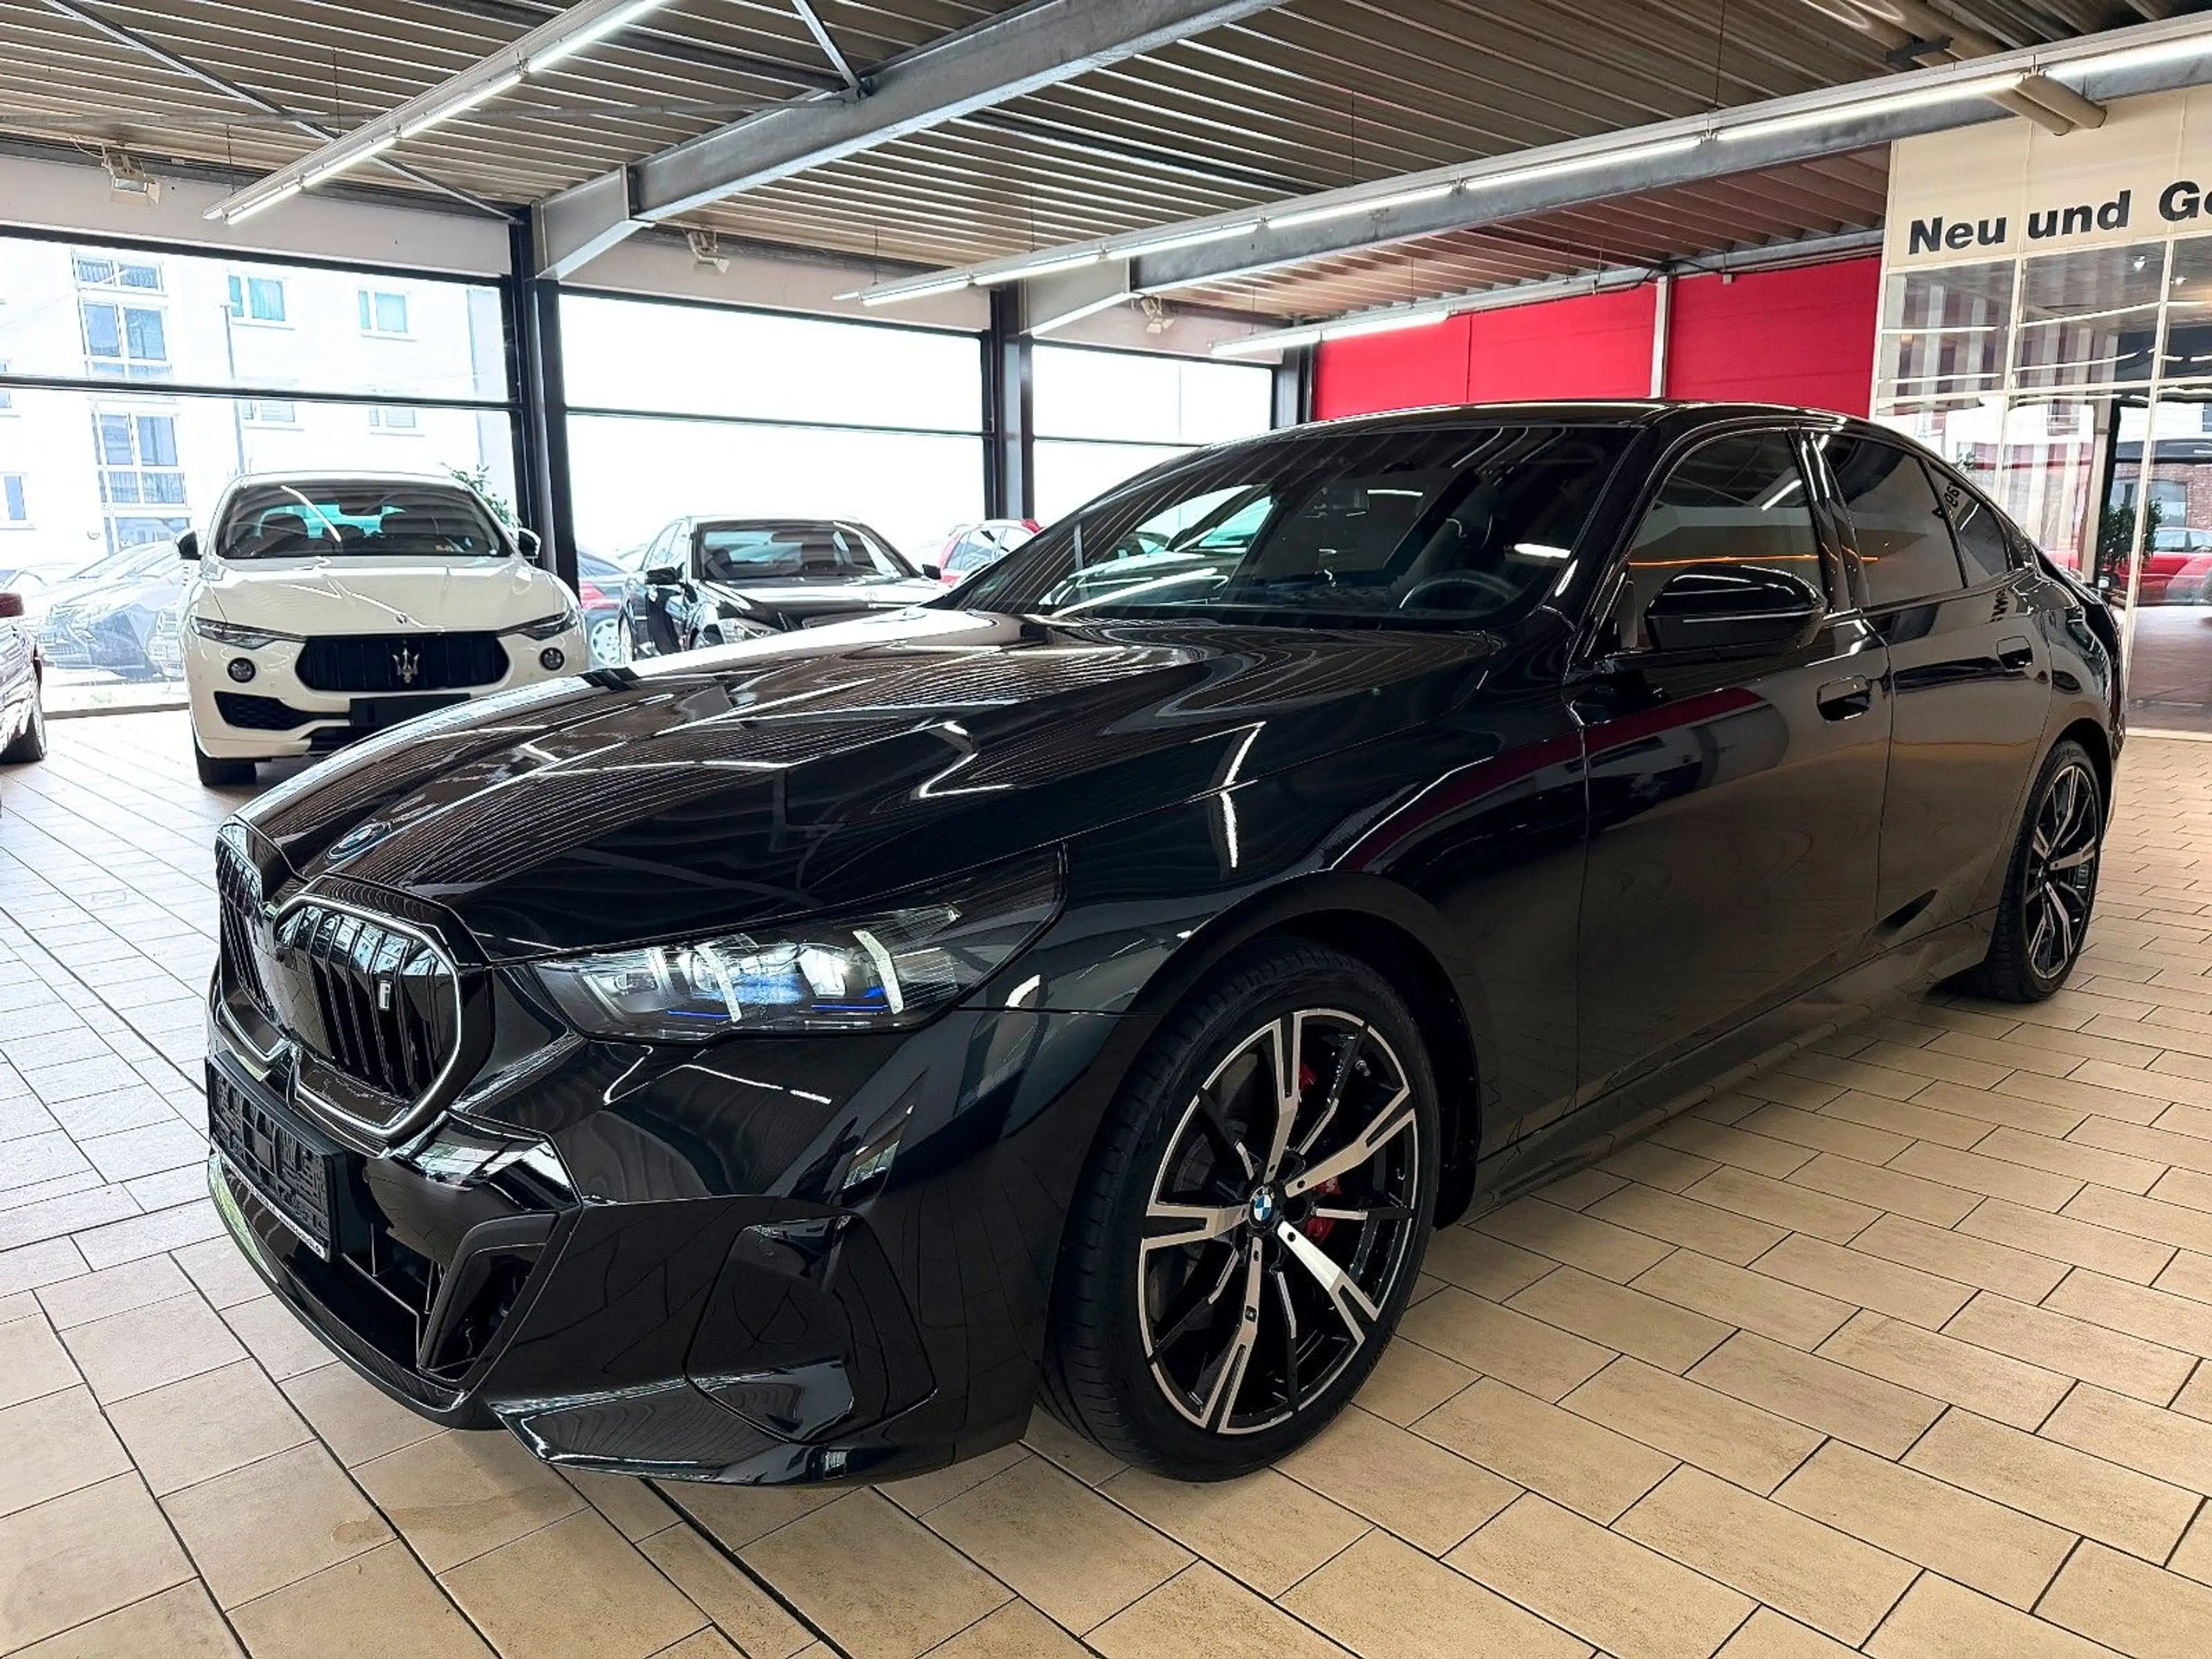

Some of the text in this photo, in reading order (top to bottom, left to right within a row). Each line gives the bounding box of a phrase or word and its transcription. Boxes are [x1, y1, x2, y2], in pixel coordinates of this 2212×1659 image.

[1909, 181, 2212, 255] Neu und G
